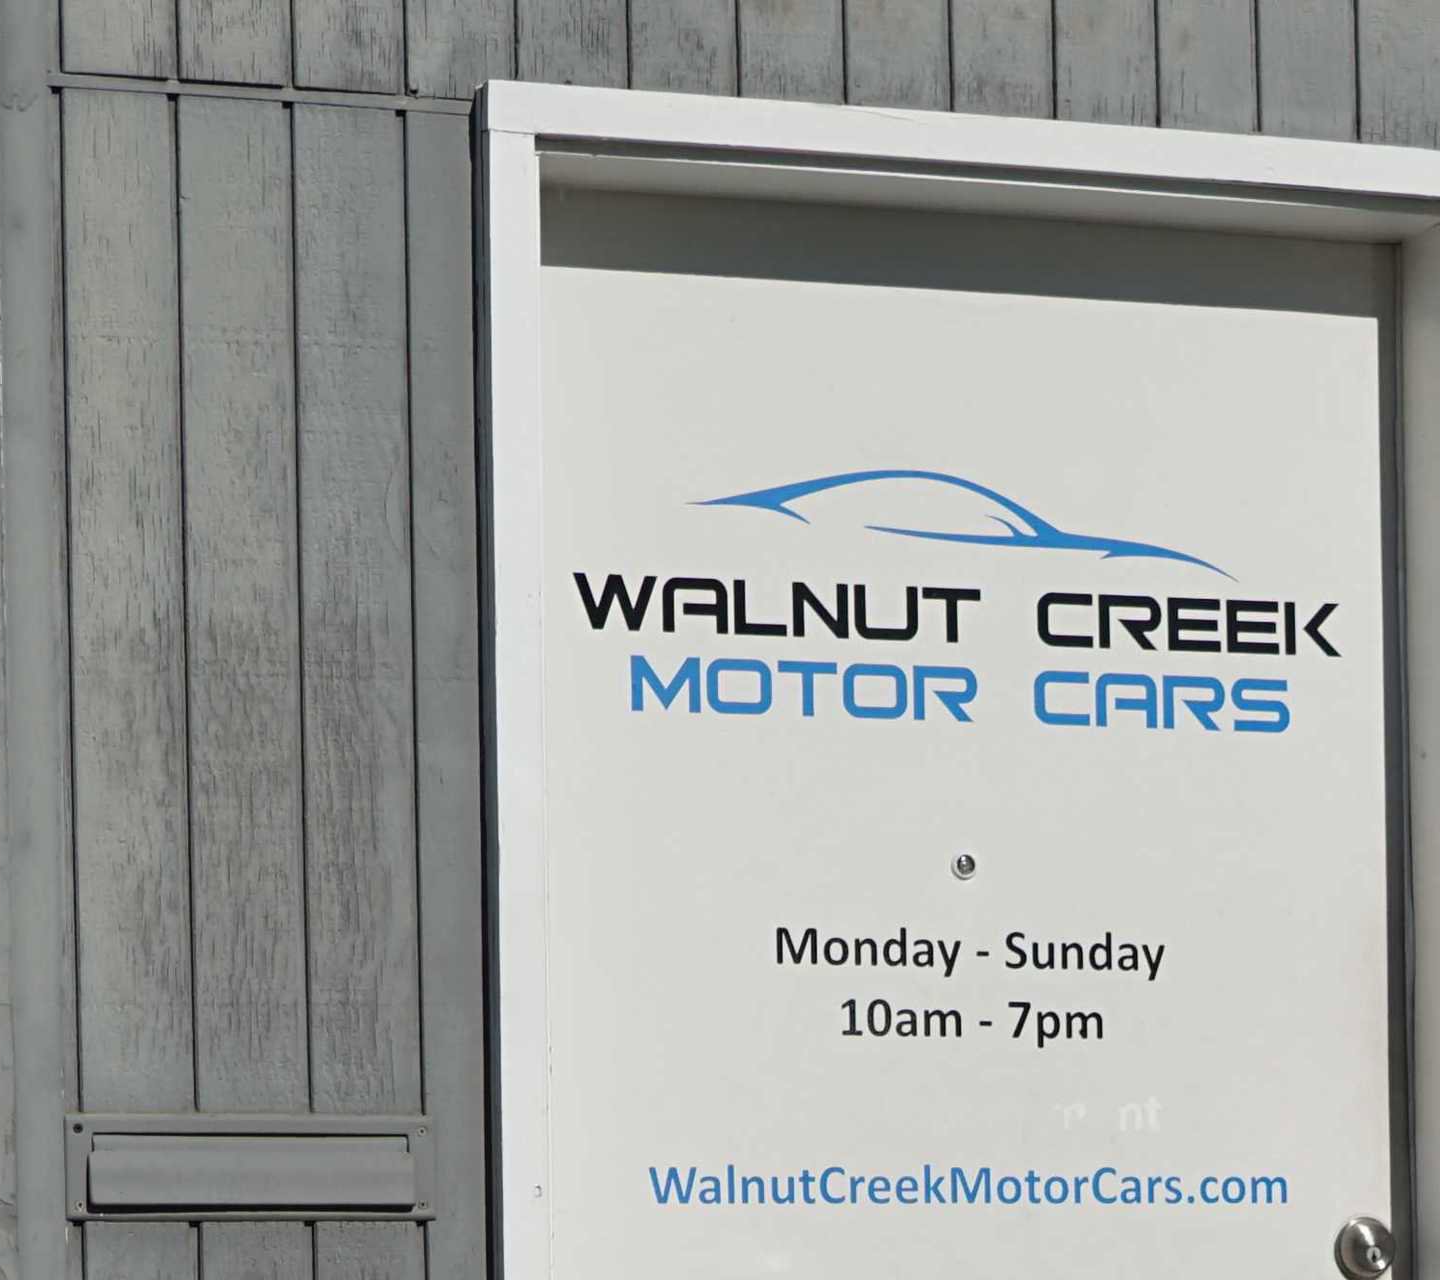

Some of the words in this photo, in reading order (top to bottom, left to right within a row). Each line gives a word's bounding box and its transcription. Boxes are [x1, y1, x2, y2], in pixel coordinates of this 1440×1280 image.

[572, 571, 982, 645] WALNUT
[1036, 591, 1343, 659] CREEK
[629, 654, 979, 723] MOTOR
[1033, 670, 1291, 734] CARS
[775, 926, 962, 978] Monday
[1004, 931, 1166, 982] Sunday
[840, 998, 963, 1039] 10am
[1007, 1000, 1105, 1049] 7pm
[648, 1163, 1289, 1206] WalnutCreekMotorCars.com
